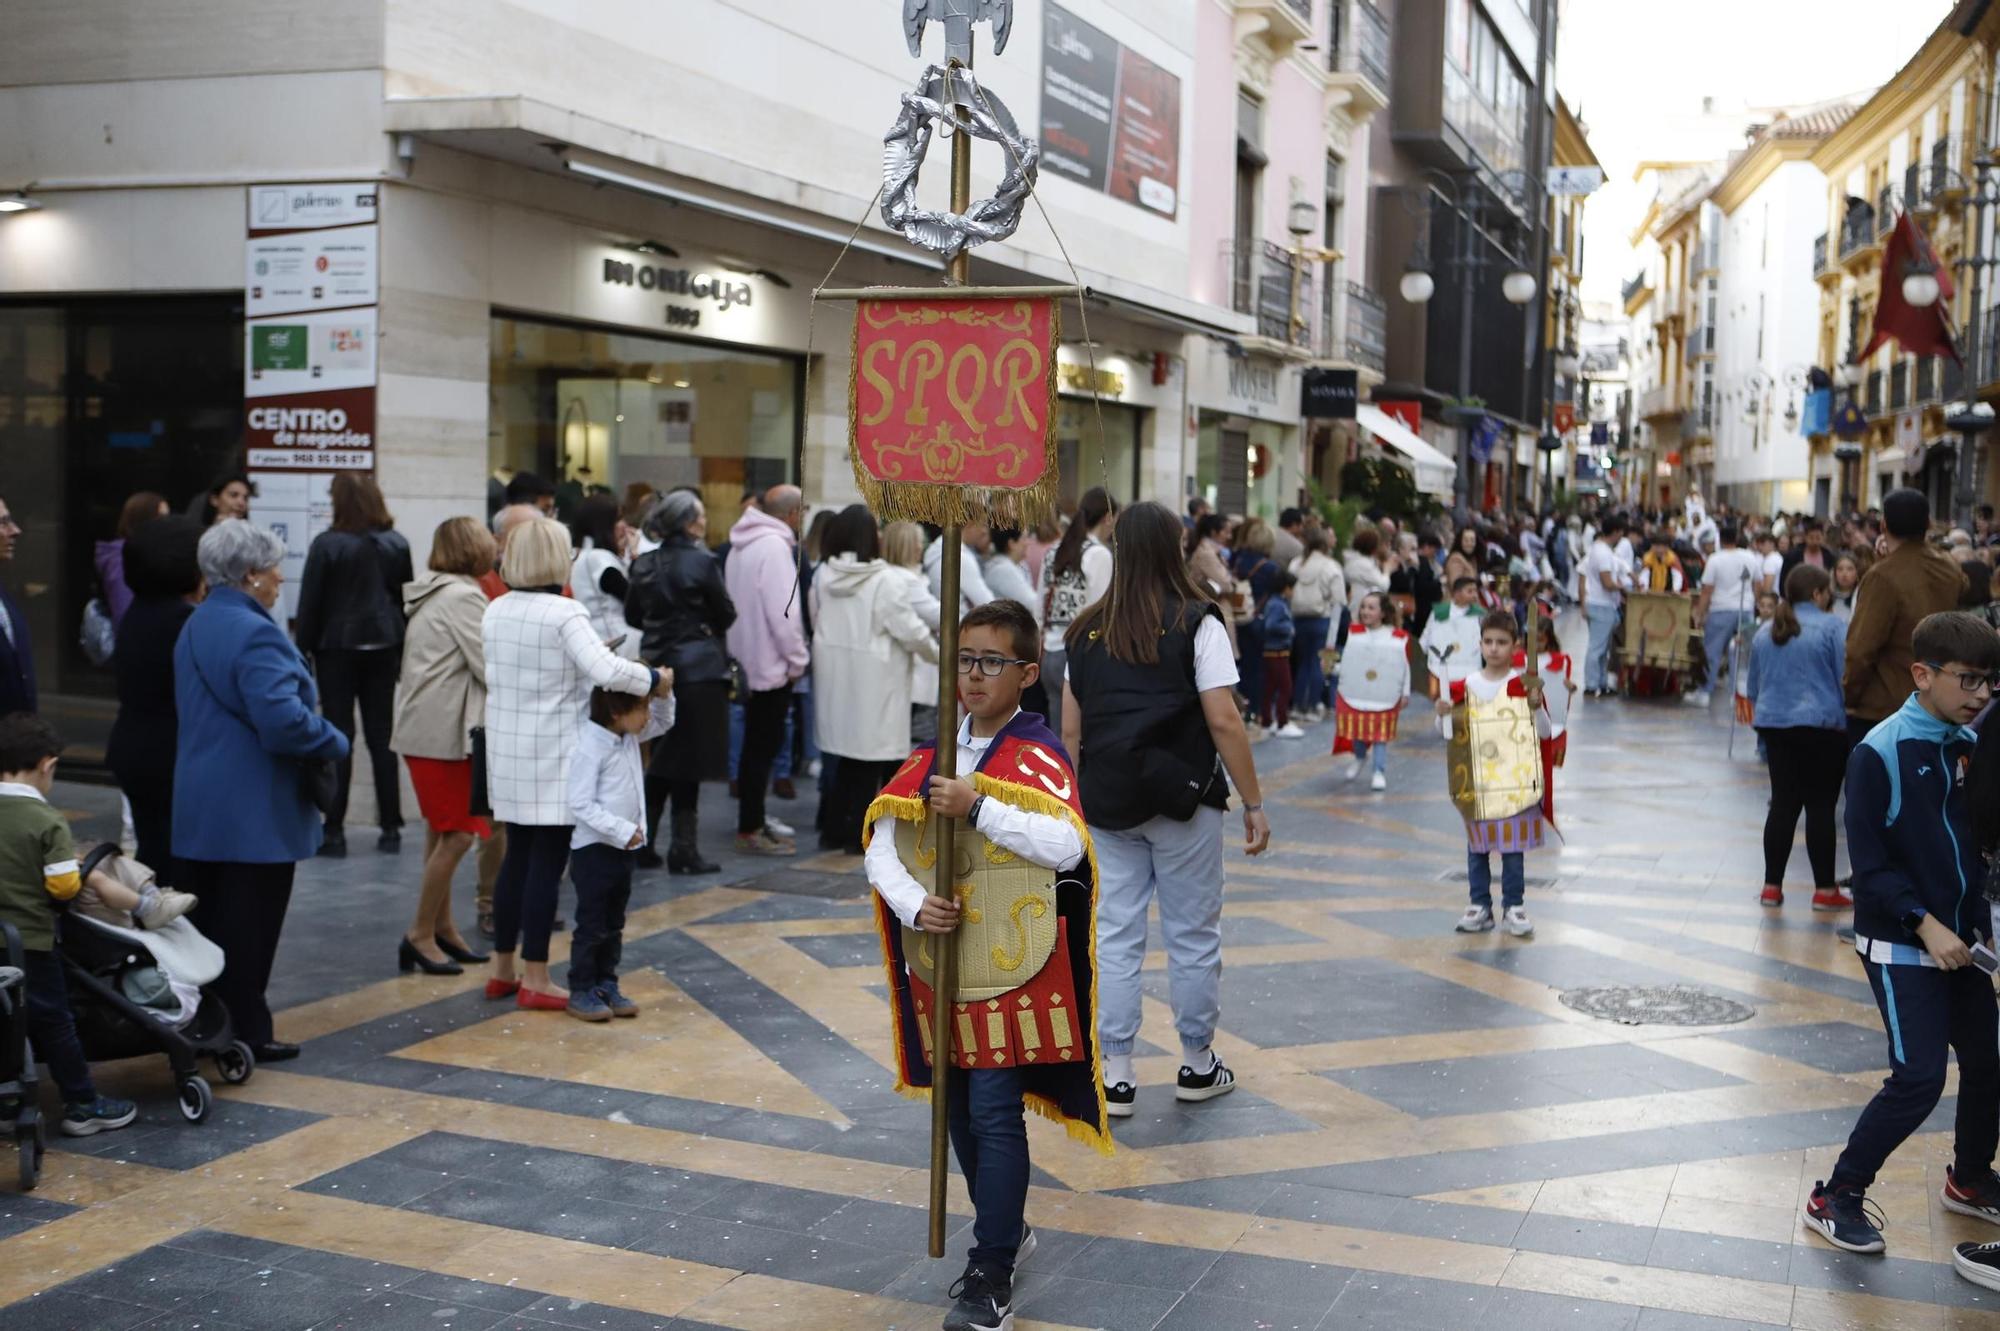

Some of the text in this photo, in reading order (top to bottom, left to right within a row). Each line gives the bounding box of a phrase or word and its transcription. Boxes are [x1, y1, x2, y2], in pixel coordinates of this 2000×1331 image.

[603, 258, 752, 312] montoya
[862, 338, 1042, 434] SPQR
[248, 408, 347, 431] CENTRO
[273, 429, 371, 449] de negocios
